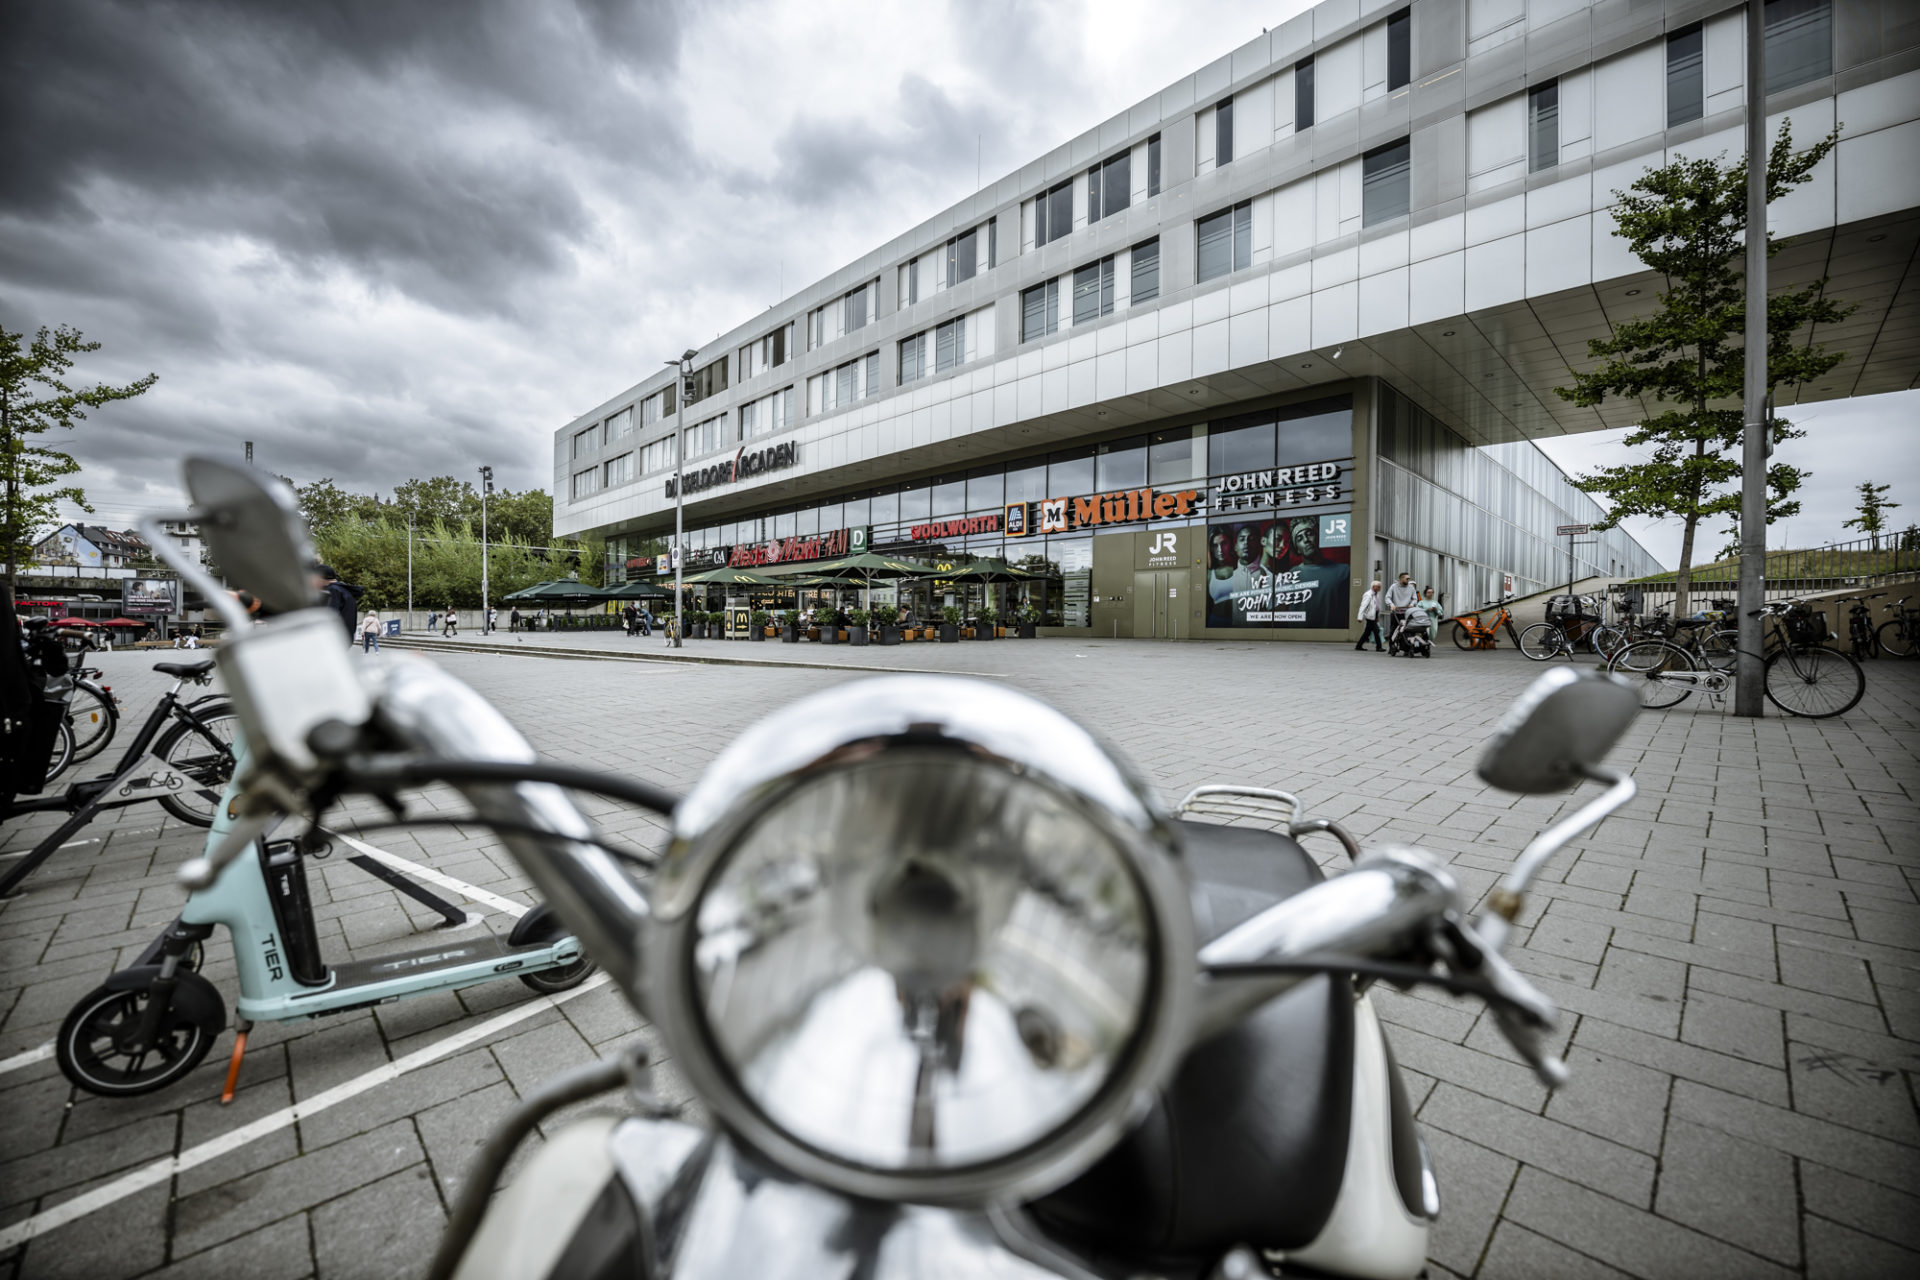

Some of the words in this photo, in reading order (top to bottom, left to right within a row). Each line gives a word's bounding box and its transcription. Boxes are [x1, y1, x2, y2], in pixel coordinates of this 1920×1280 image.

[733, 440, 797, 479] ARCADEN
[1215, 470, 1272, 492] JOHN
[1277, 462, 1337, 485] REED
[1072, 488, 1198, 526] Müller
[1214, 485, 1336, 510] FITNESS
[910, 513, 998, 540] WOOLWORTH
[1046, 507, 1061, 523] M
[1325, 519, 1347, 534] JR
[1148, 532, 1177, 555] JR
[1251, 574, 1271, 590] WE
[1275, 570, 1302, 587] ARE
[1238, 592, 1273, 611] JOHN
[1275, 589, 1313, 606] REED
[260, 932, 284, 982] TIER
[383, 949, 466, 970] TIER
